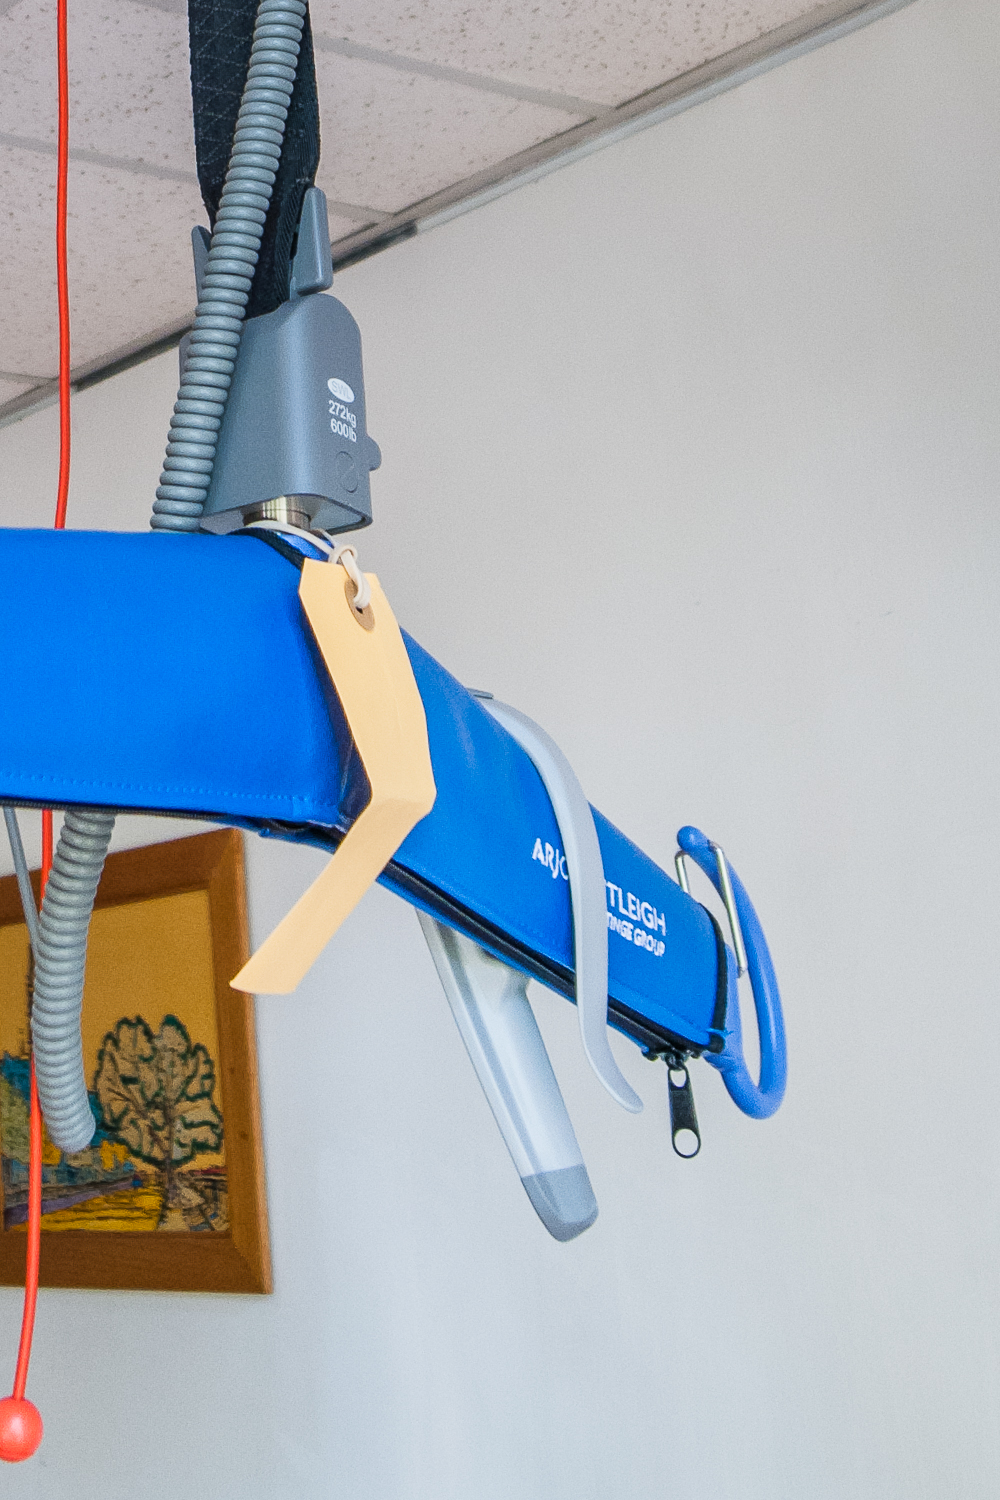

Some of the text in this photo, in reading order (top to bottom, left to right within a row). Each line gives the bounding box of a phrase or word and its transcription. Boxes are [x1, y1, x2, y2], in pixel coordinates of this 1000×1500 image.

[328, 399, 357, 429] 272kg
[330, 418, 357, 443] 600lb
[633, 928, 666, 957] GROUP
